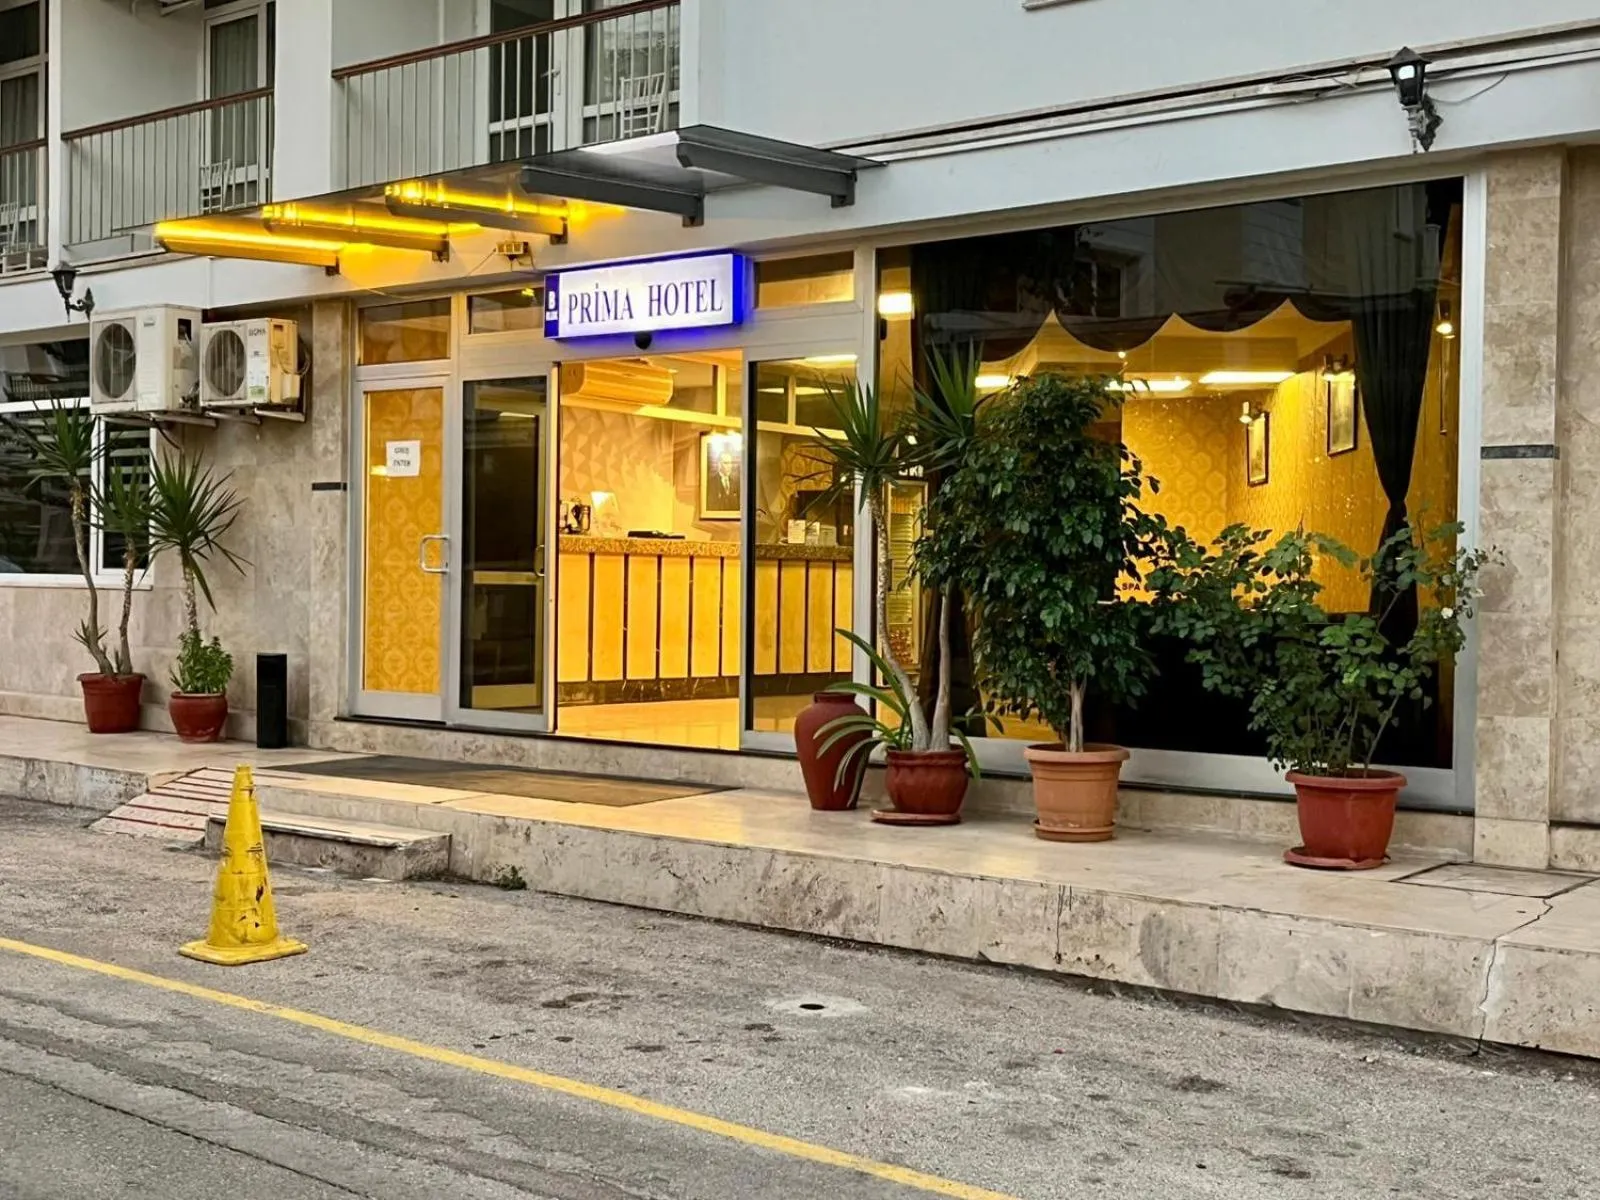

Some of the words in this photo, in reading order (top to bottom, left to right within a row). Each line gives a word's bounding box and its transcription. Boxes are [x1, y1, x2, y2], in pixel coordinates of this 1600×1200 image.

[568, 282, 634, 325] PRİMA
[648, 279, 723, 317] HOTEL
[1122, 583, 1141, 591] SPA
